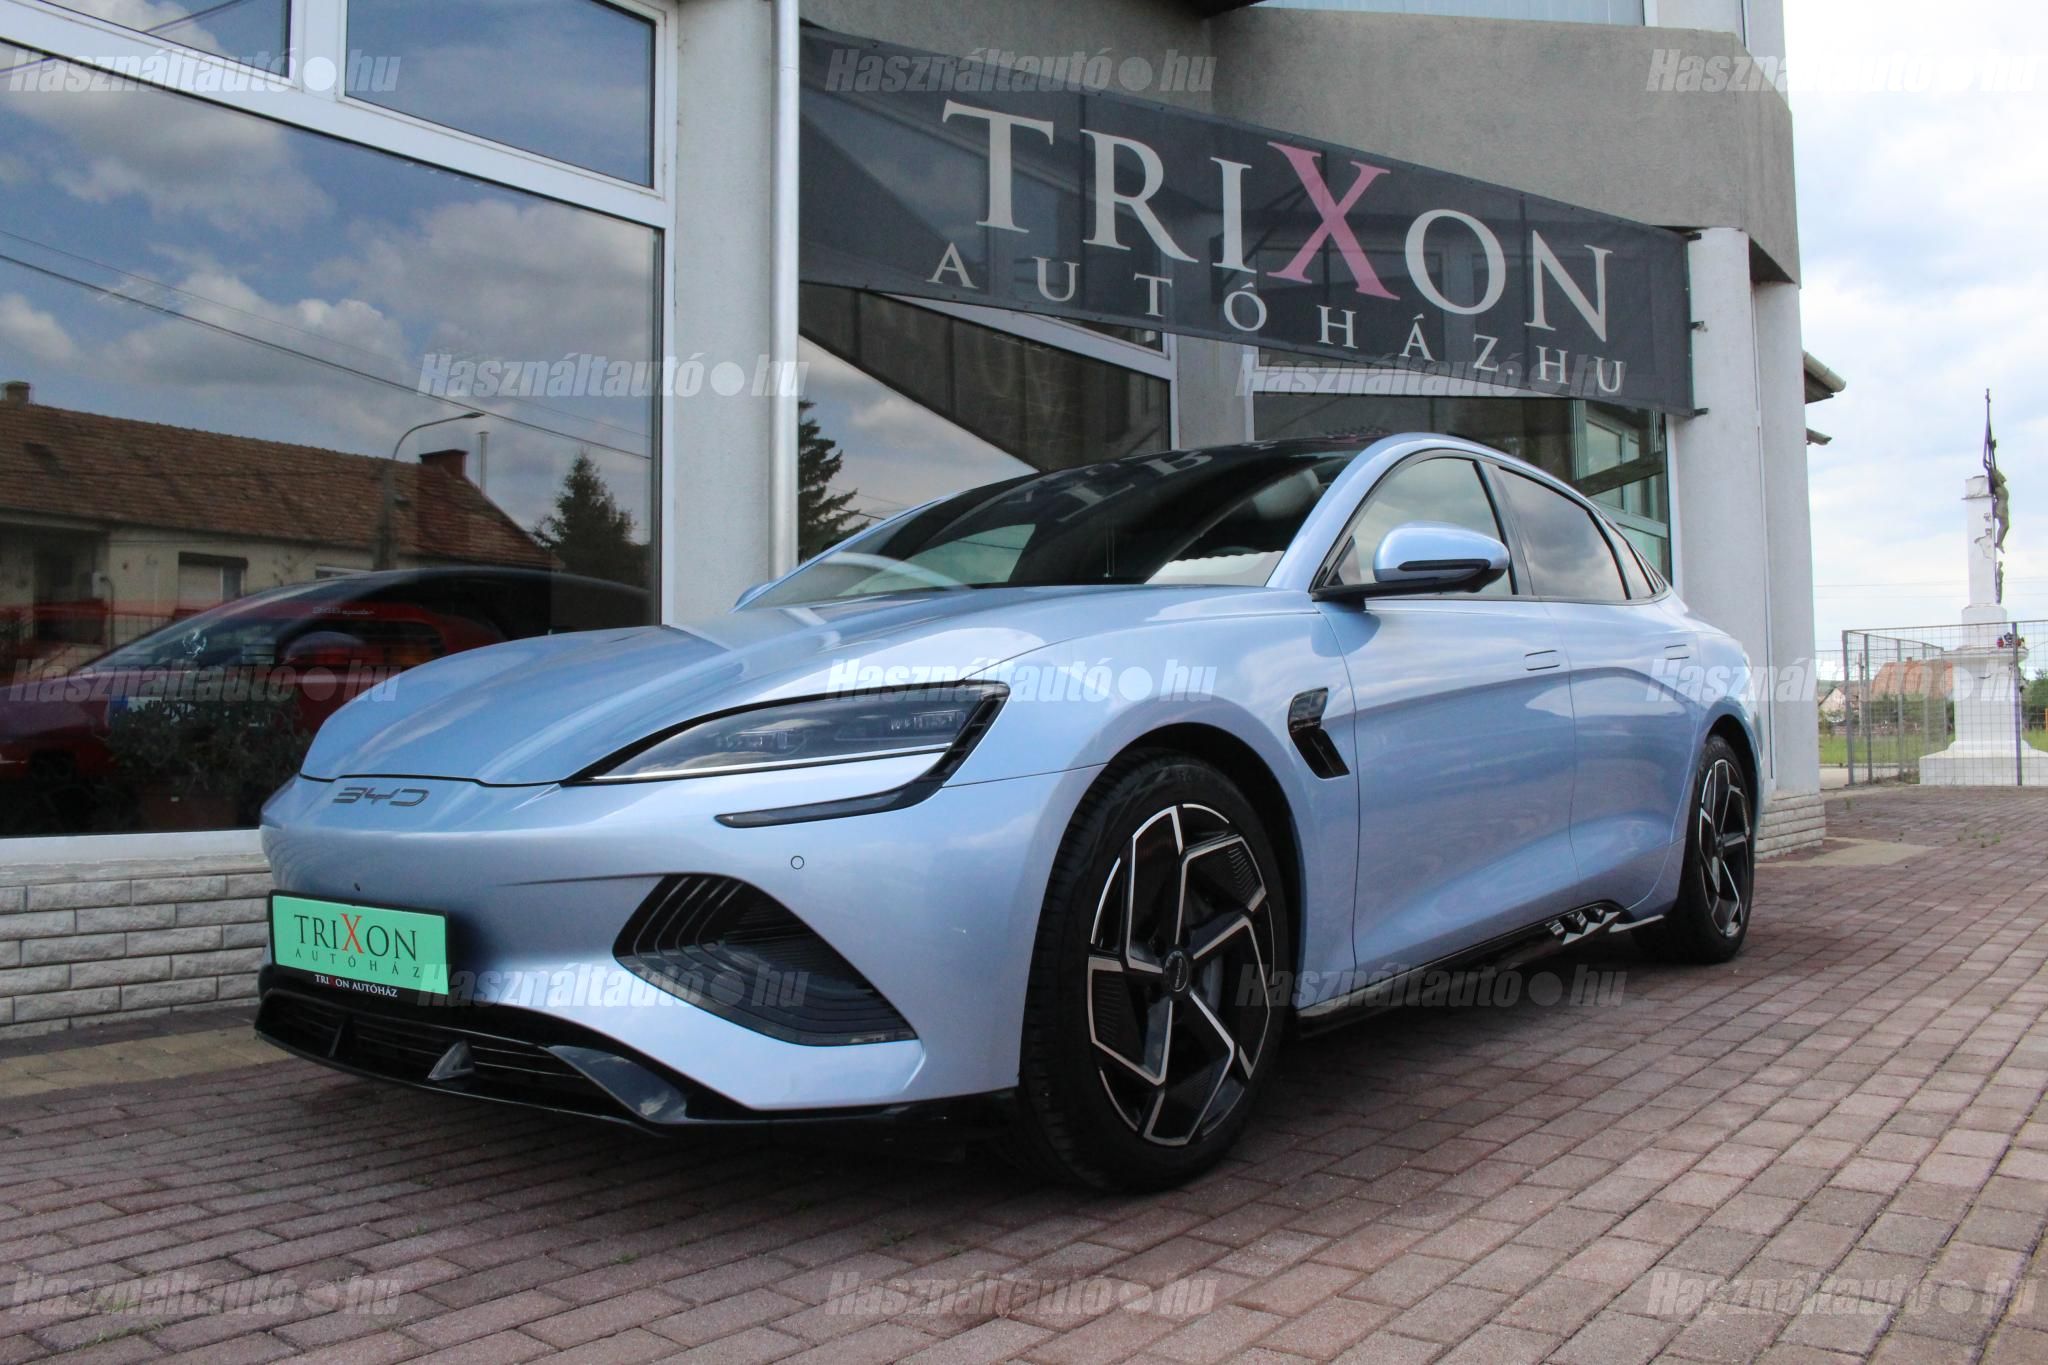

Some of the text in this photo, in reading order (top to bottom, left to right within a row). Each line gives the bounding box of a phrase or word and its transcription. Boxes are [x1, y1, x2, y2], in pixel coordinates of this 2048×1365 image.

[942, 99, 1613, 343] TRIXON
[294, 913, 416, 961] TRIXON
[352, 982, 397, 998] AUTÓHÁZ
